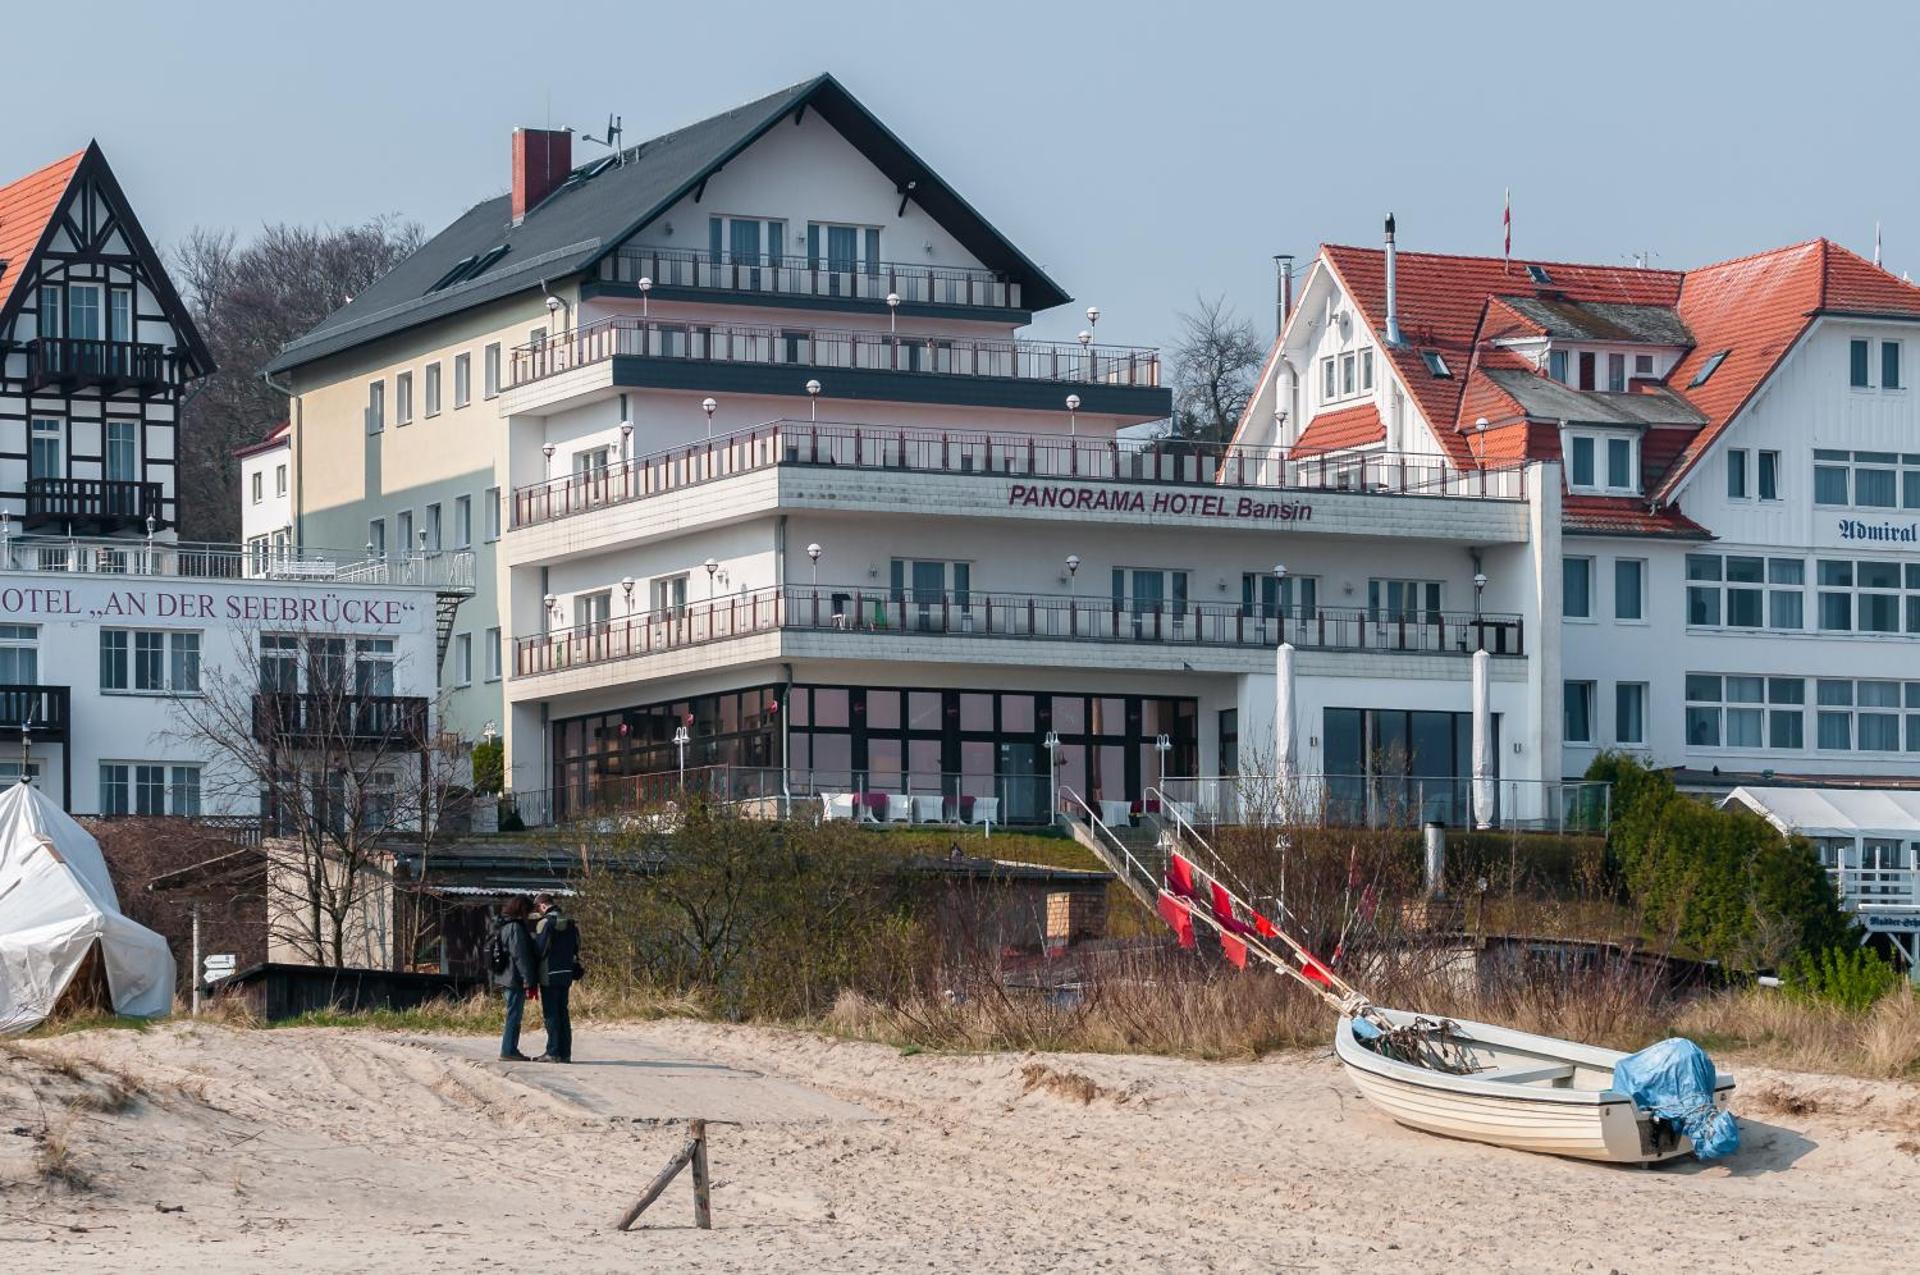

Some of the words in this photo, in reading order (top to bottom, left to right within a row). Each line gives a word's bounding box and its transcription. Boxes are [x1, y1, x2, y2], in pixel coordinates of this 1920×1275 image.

[1009, 484, 1145, 512] PANORAMA
[1152, 492, 1230, 517] HOTEL
[1236, 497, 1312, 521] Bansin
[1838, 519, 1918, 542] Admiral
[2, 588, 81, 614] OTEL
[157, 593, 217, 618] DER
